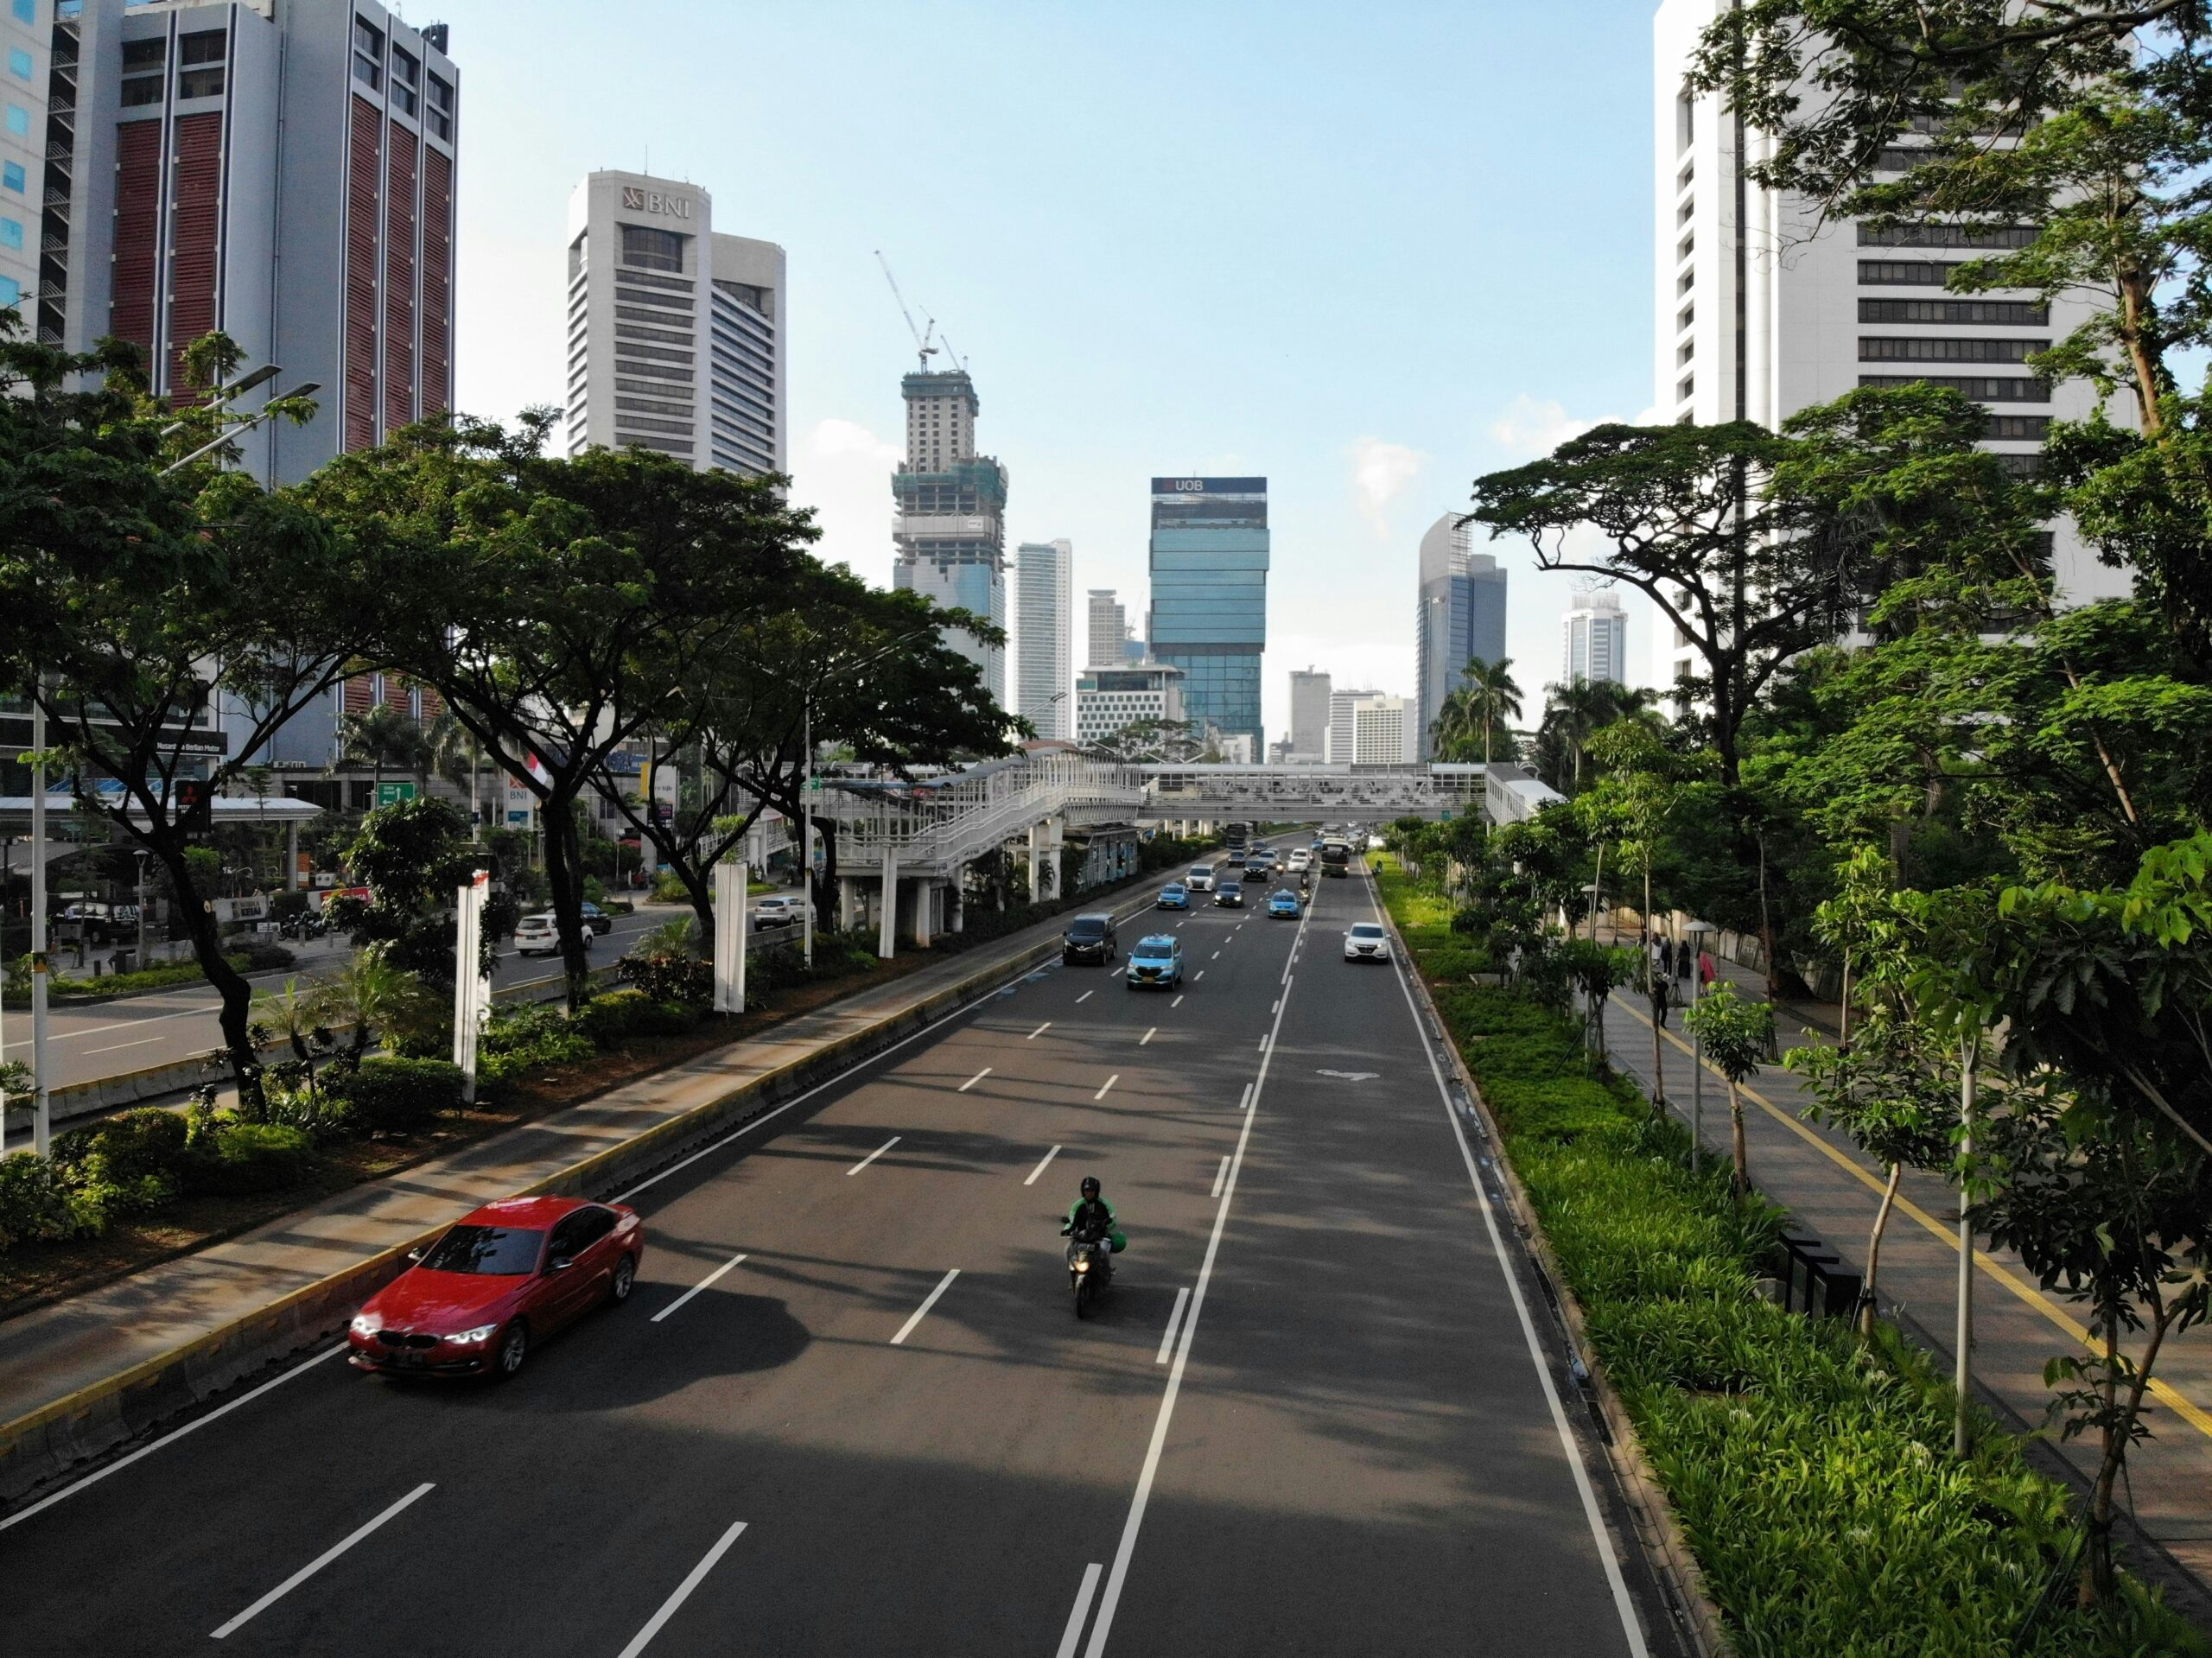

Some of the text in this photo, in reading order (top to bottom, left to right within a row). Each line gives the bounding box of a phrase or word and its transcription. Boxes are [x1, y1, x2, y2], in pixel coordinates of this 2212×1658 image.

[649, 193, 690, 219] BNI
[1175, 480, 1204, 491] UOB
[510, 791, 527, 799] BNI
